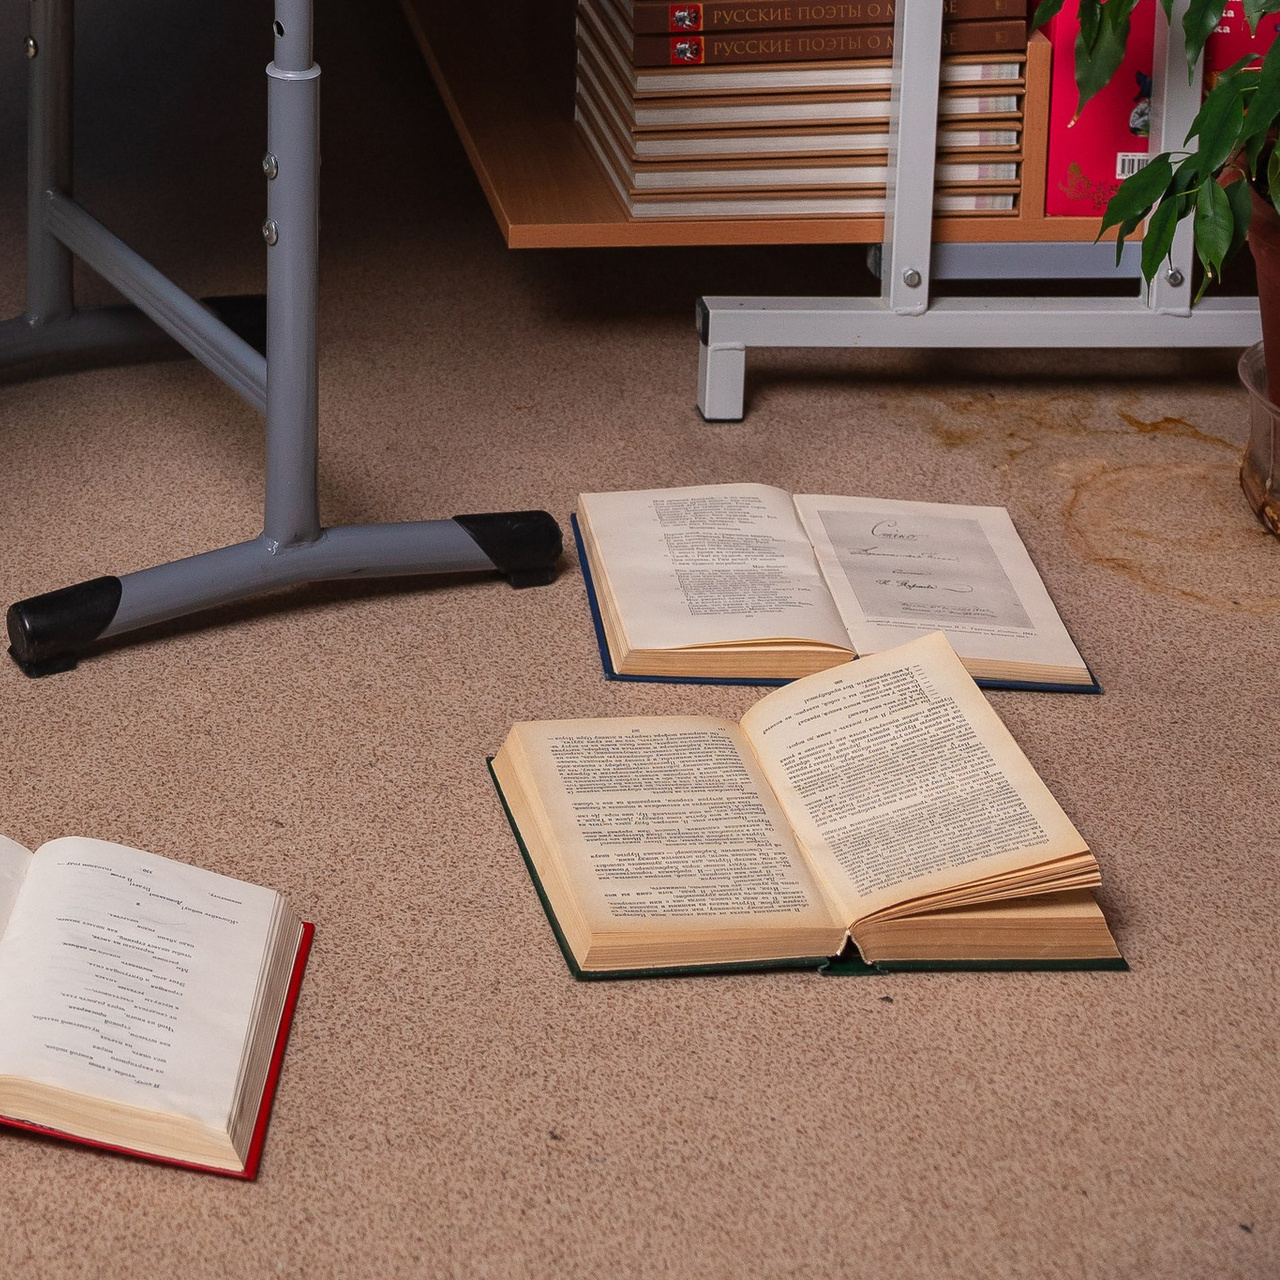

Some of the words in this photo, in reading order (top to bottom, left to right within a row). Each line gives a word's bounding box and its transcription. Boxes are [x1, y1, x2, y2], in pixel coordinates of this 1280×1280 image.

[713, 3, 792, 24] РУССКИЕ
[798, 3, 862, 21] ПОЭТЫ
[867, 3, 881, 18] О
